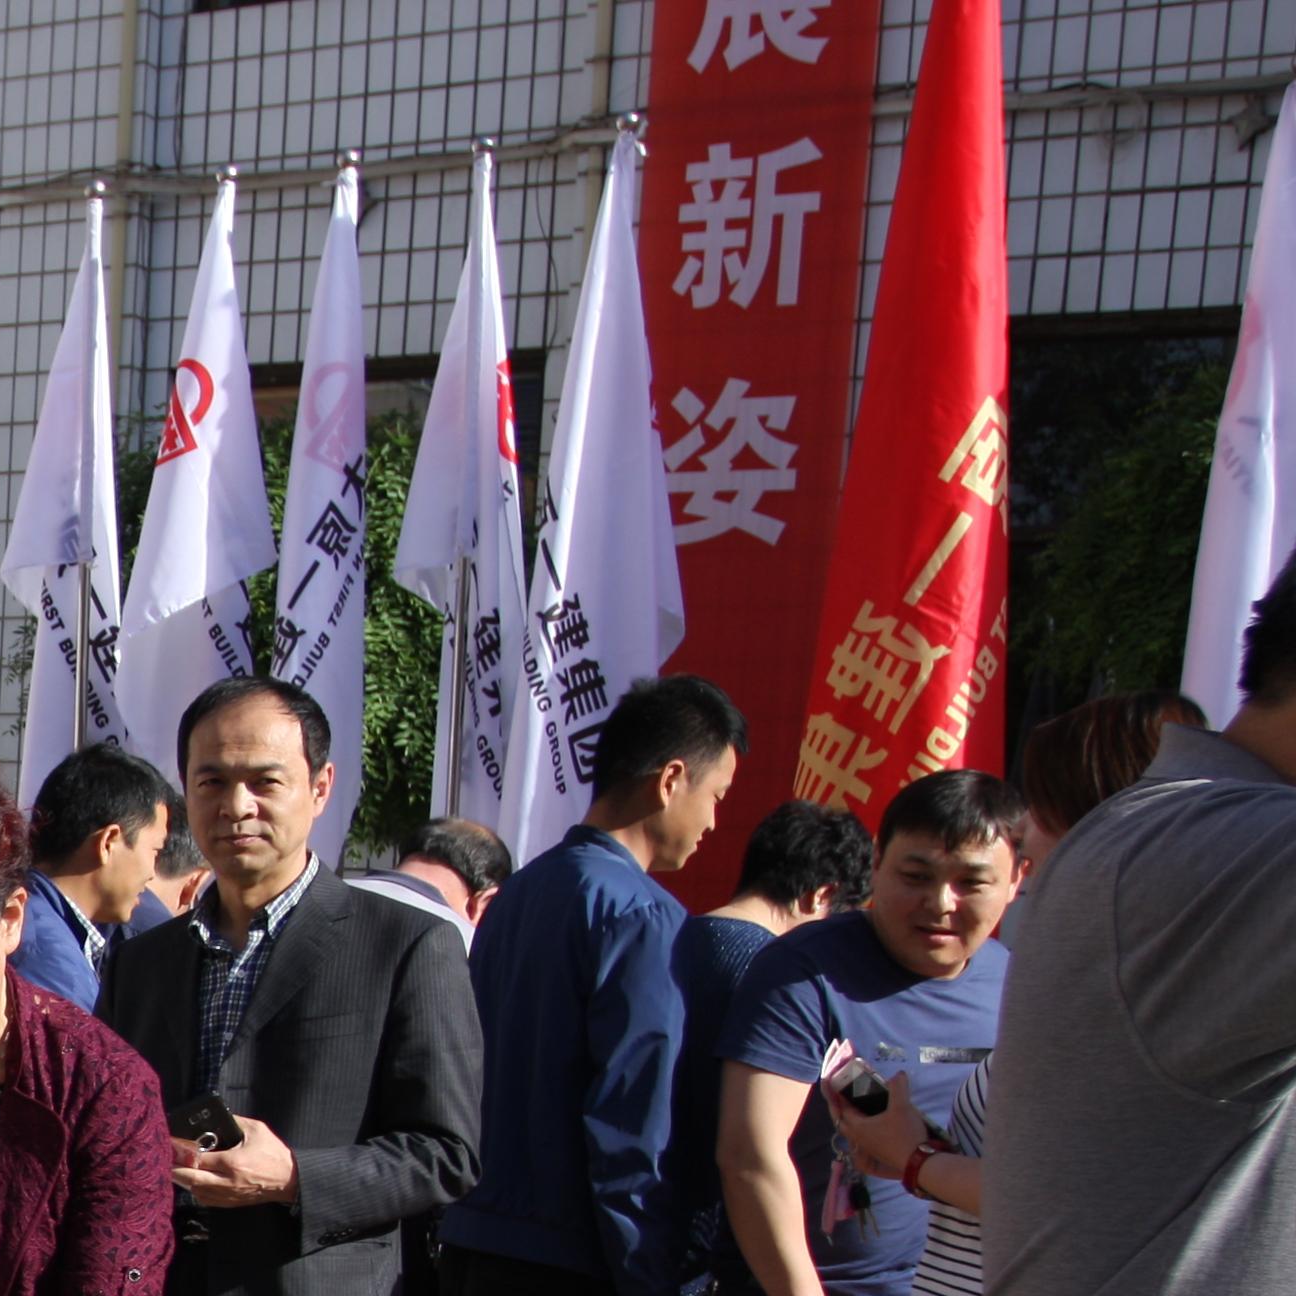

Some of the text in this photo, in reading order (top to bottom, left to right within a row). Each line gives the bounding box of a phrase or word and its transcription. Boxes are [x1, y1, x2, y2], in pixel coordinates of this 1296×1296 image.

[41, 576, 110, 729] IRST BUDING
[477, 735, 502, 800] GROU
[544, 721, 567, 795] GROUP
